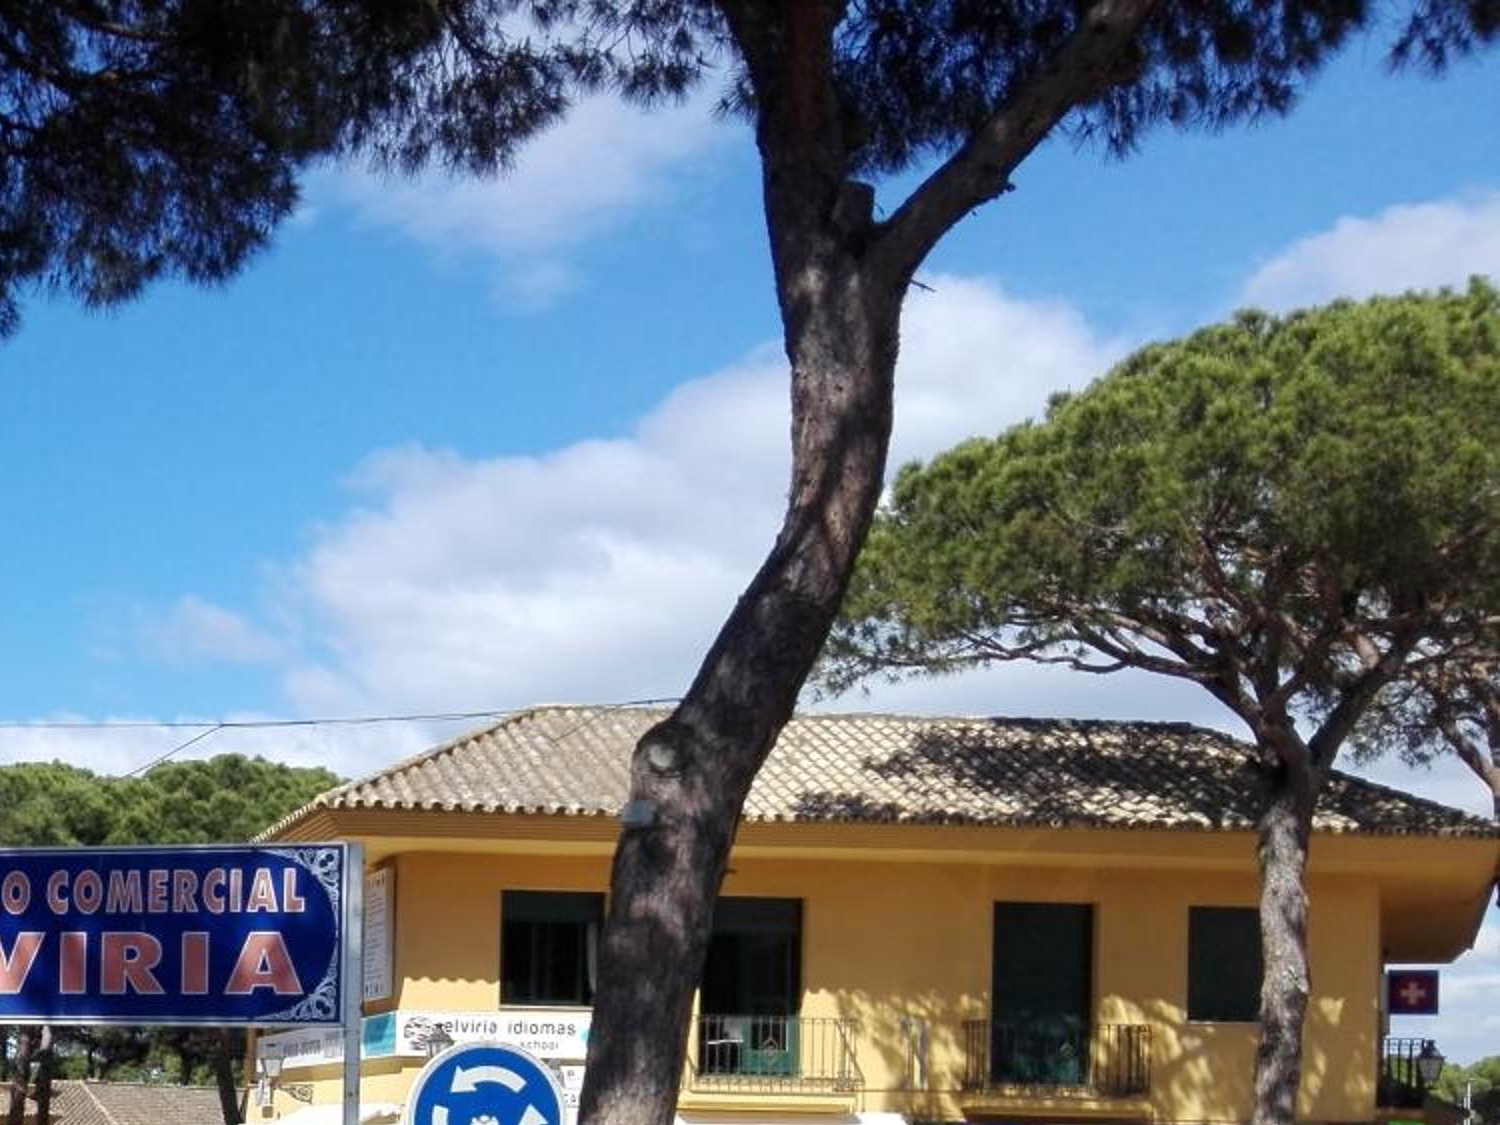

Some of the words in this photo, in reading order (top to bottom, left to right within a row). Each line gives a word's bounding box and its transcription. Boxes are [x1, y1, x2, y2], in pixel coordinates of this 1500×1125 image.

[47, 867, 306, 915] COMERCIAL
[445, 1018, 498, 1035] elviria
[507, 1019, 577, 1036] idiomas
